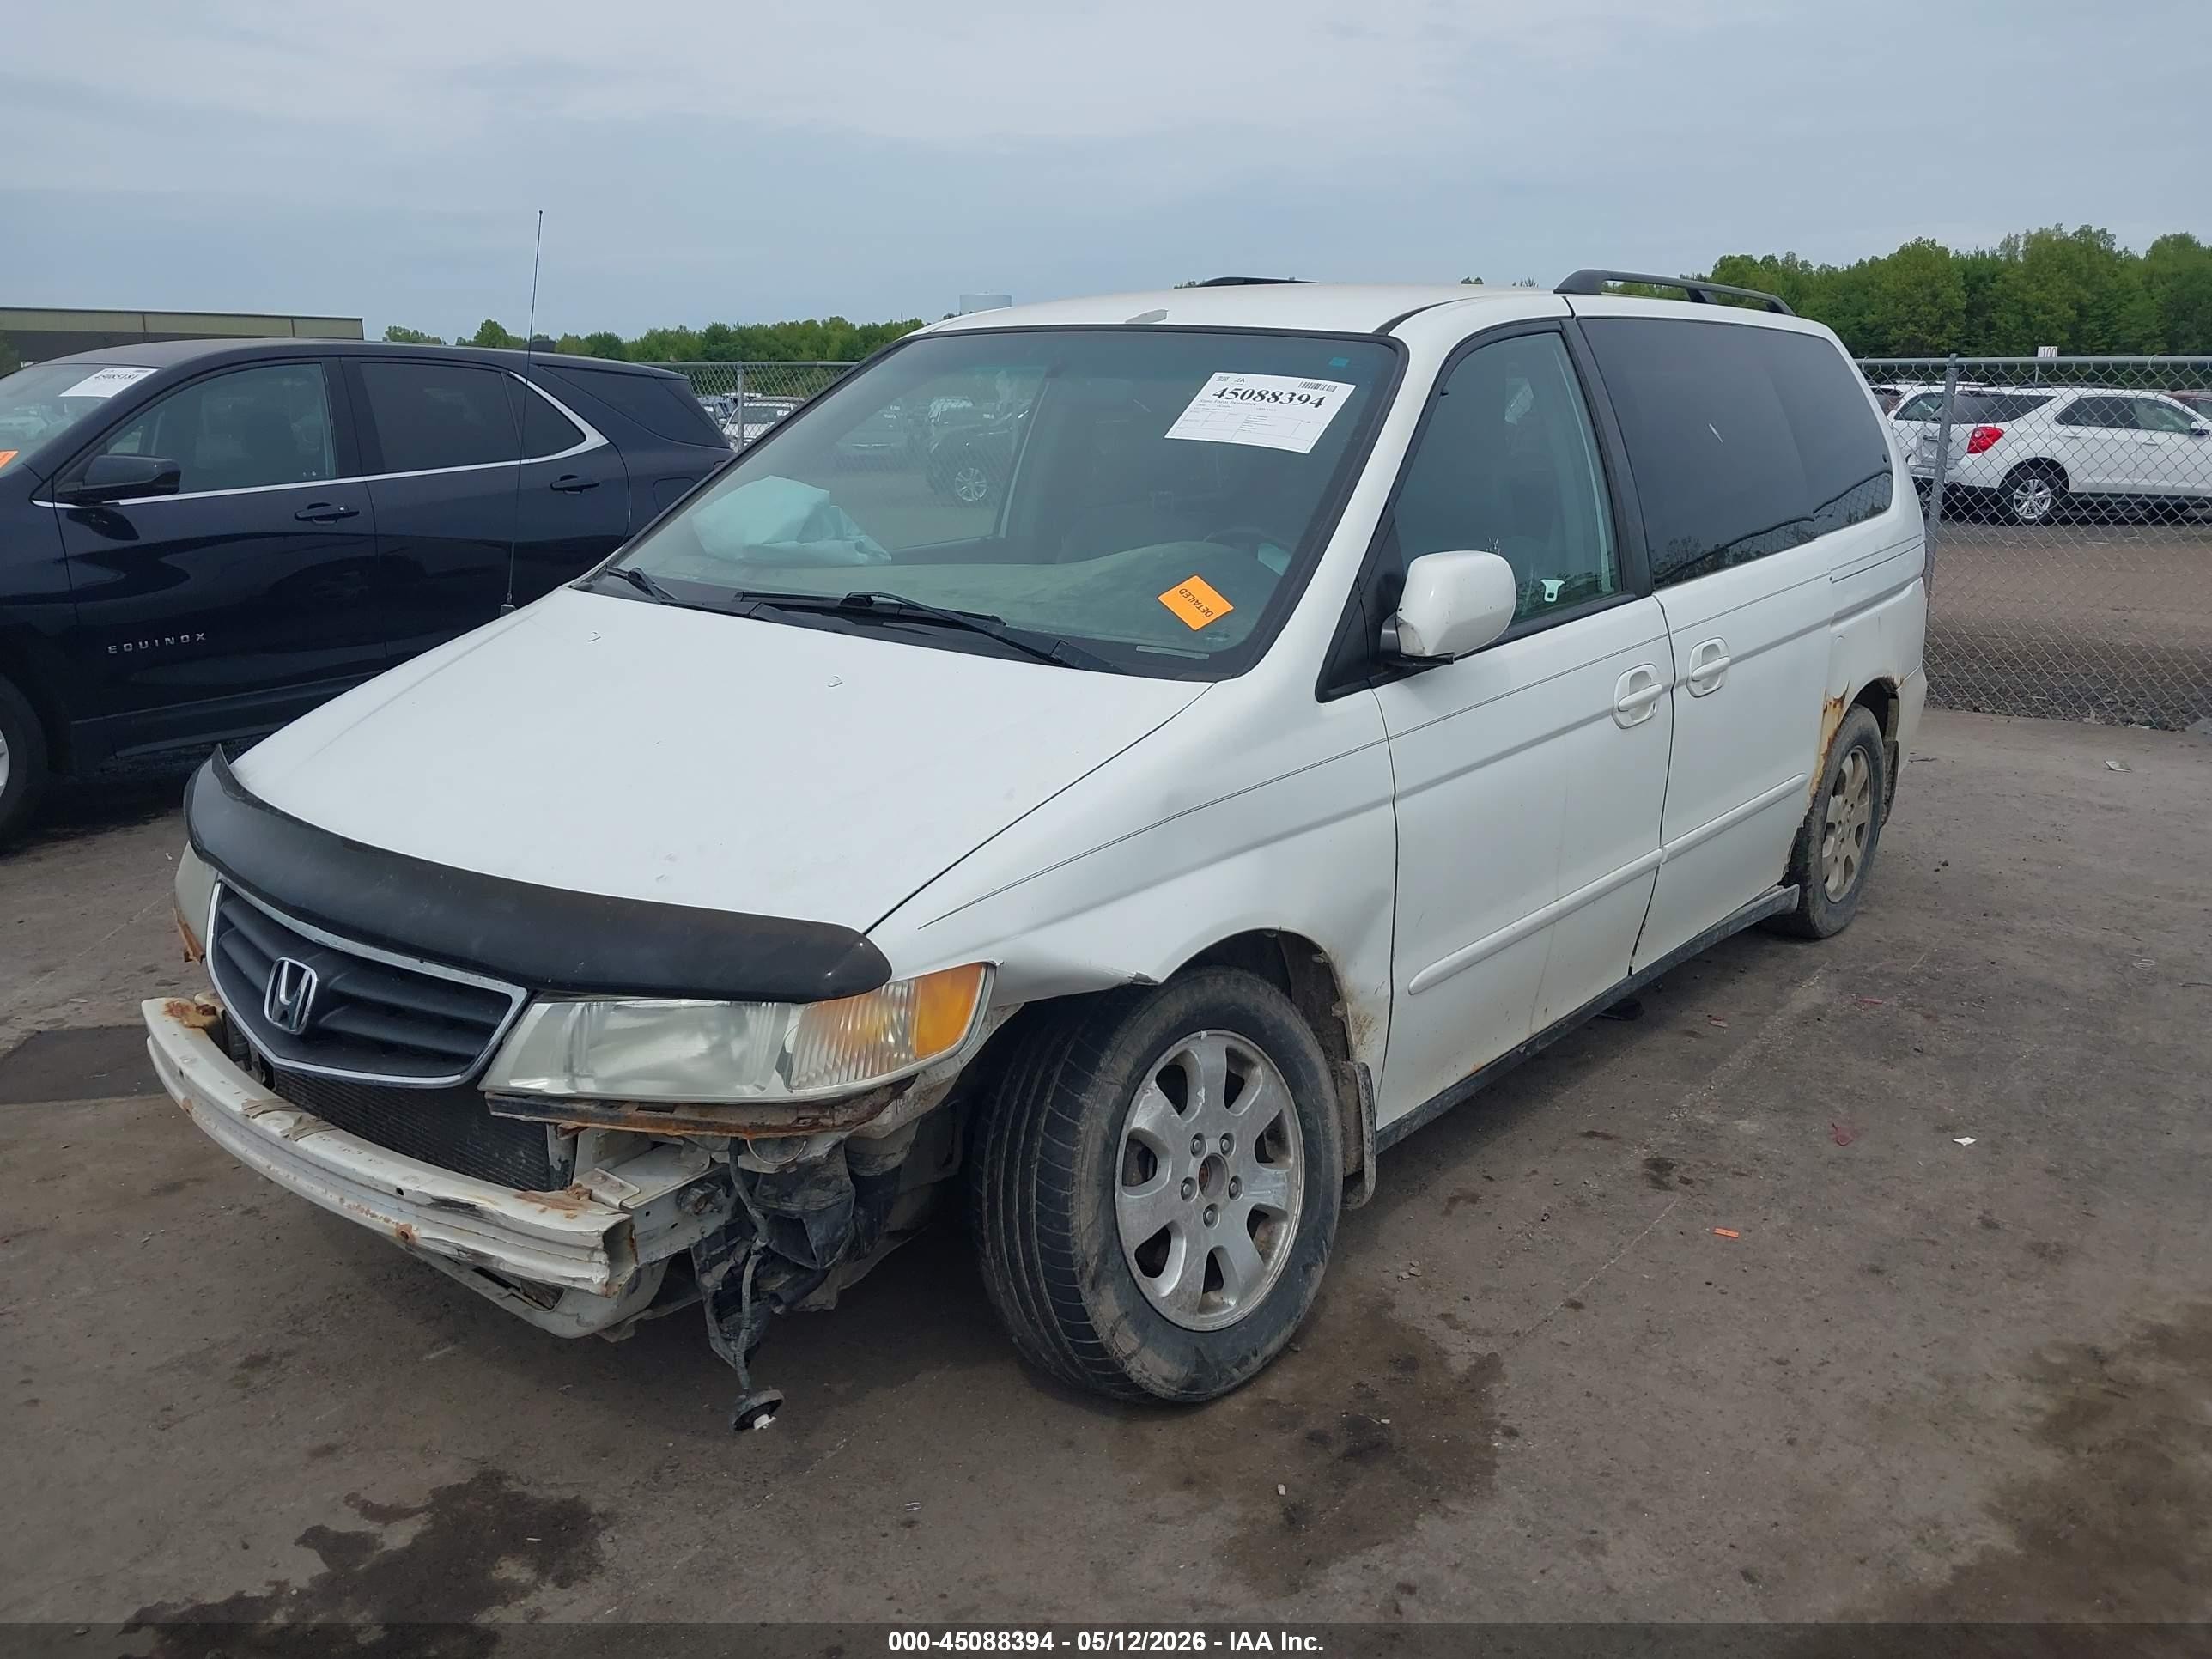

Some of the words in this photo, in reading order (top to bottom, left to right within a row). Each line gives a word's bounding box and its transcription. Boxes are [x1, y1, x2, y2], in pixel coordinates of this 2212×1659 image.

[1212, 386, 1326, 409] 45088394
[1178, 587, 1214, 618] DETAILED
[107, 632, 206, 653] EQUINOX
